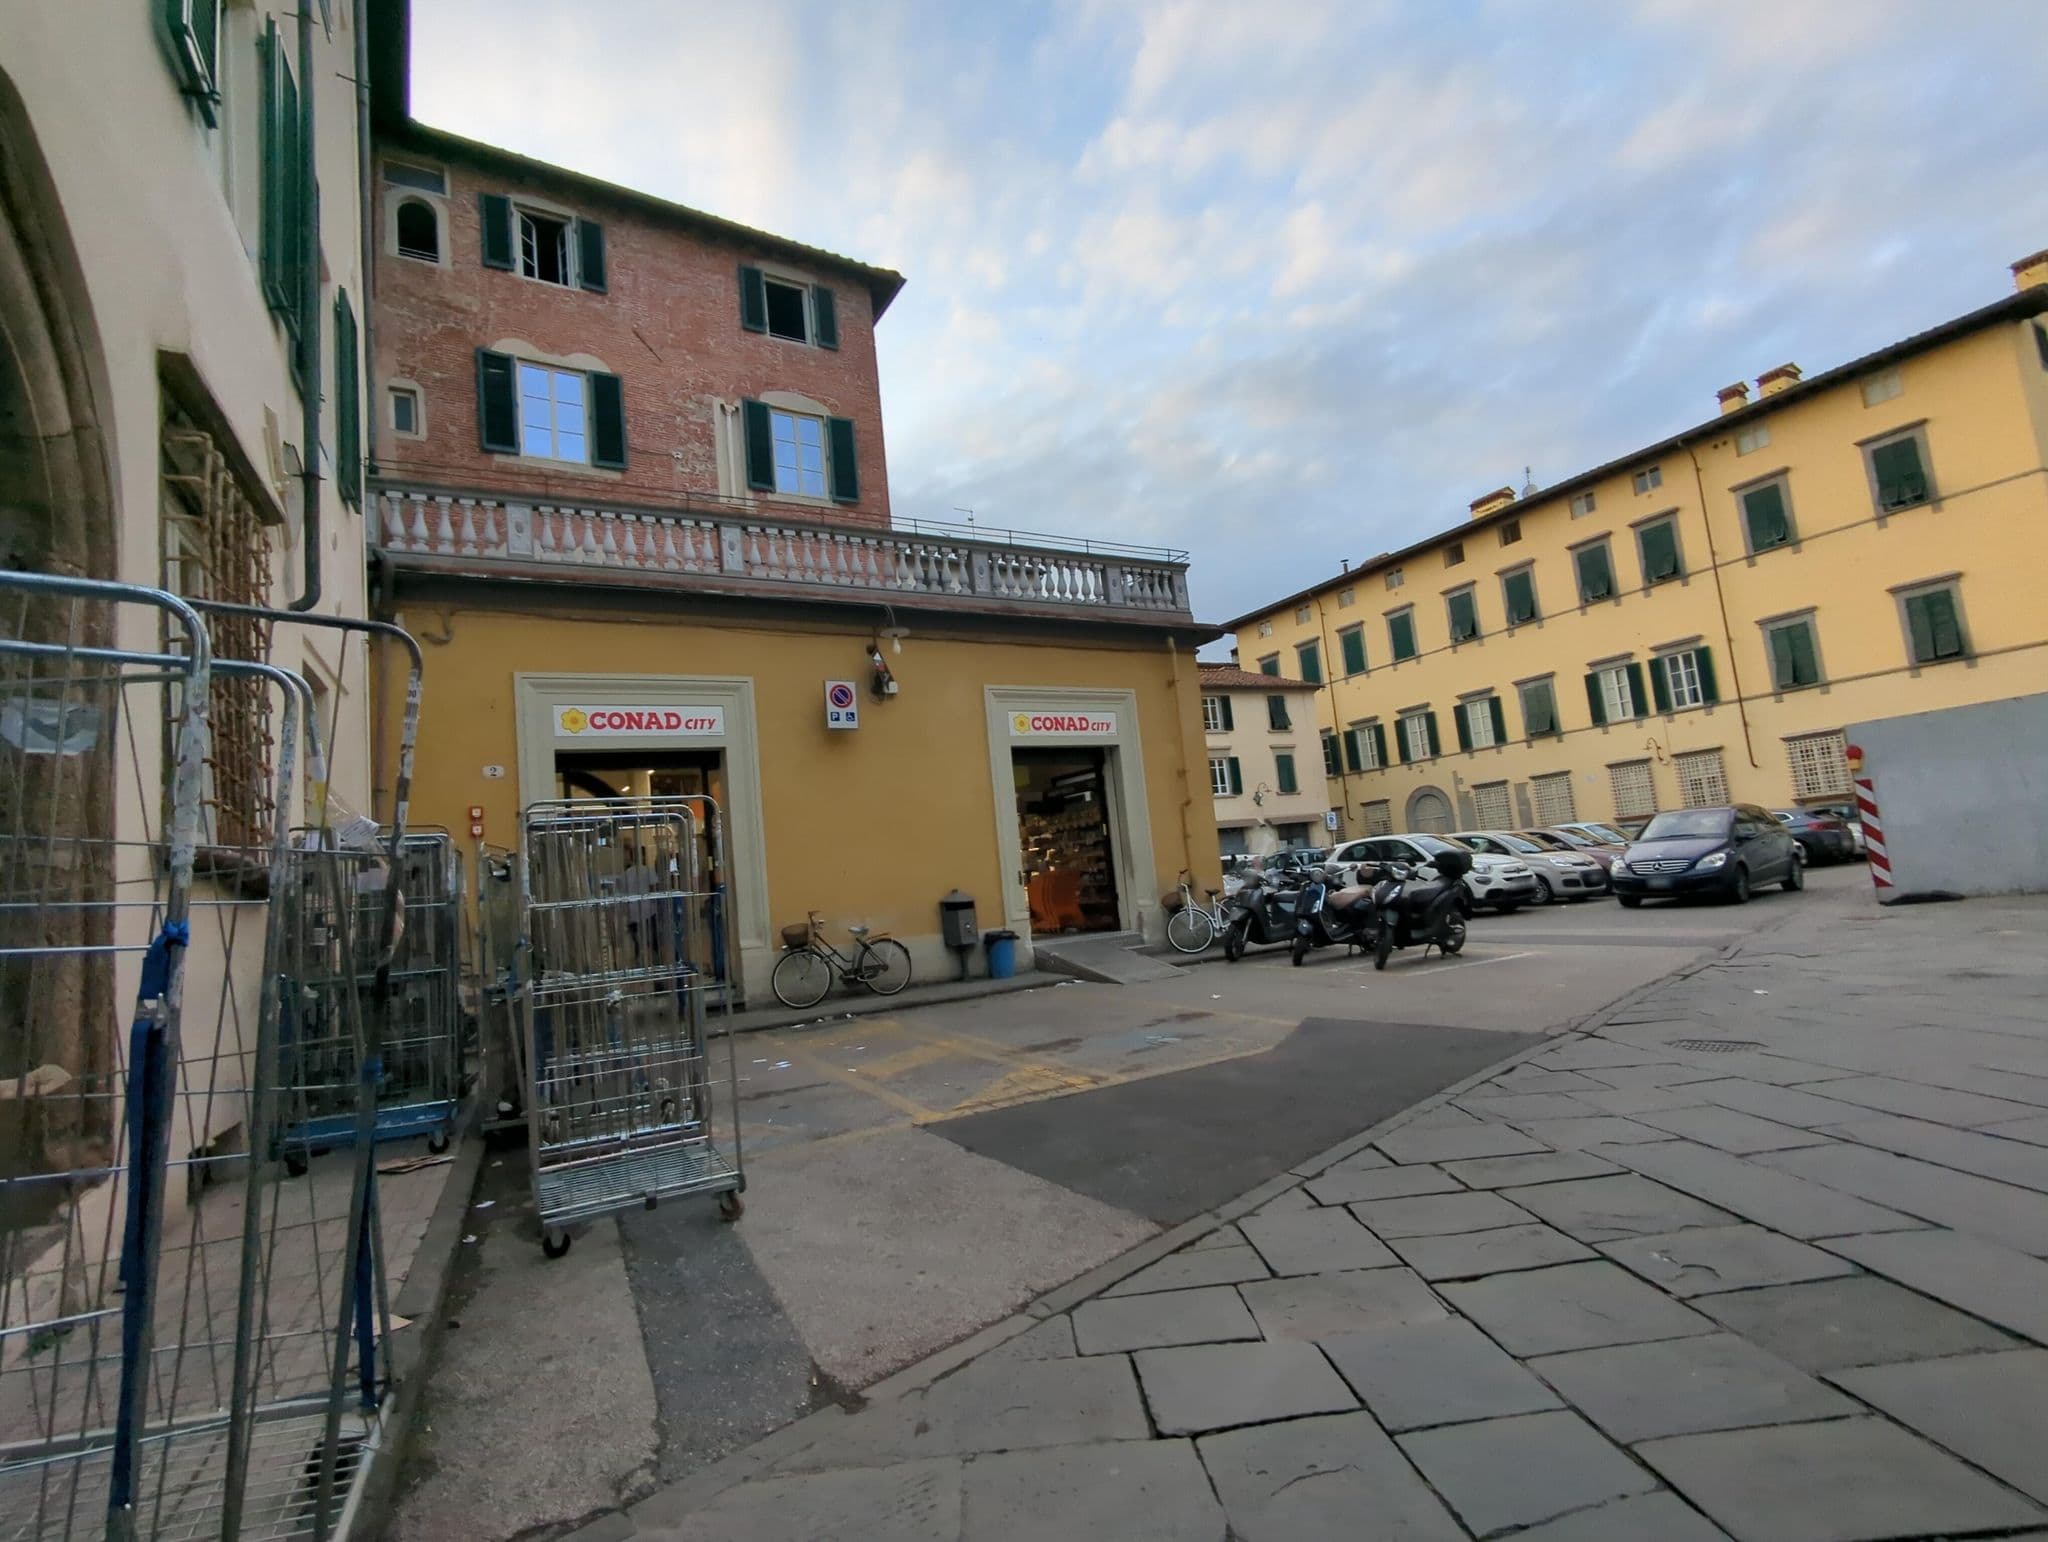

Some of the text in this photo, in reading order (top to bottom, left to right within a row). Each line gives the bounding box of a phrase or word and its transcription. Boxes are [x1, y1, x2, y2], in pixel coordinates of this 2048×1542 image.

[589, 711, 716, 730] CONAD CITY
[1031, 716, 1112, 731] CONAD CITY
